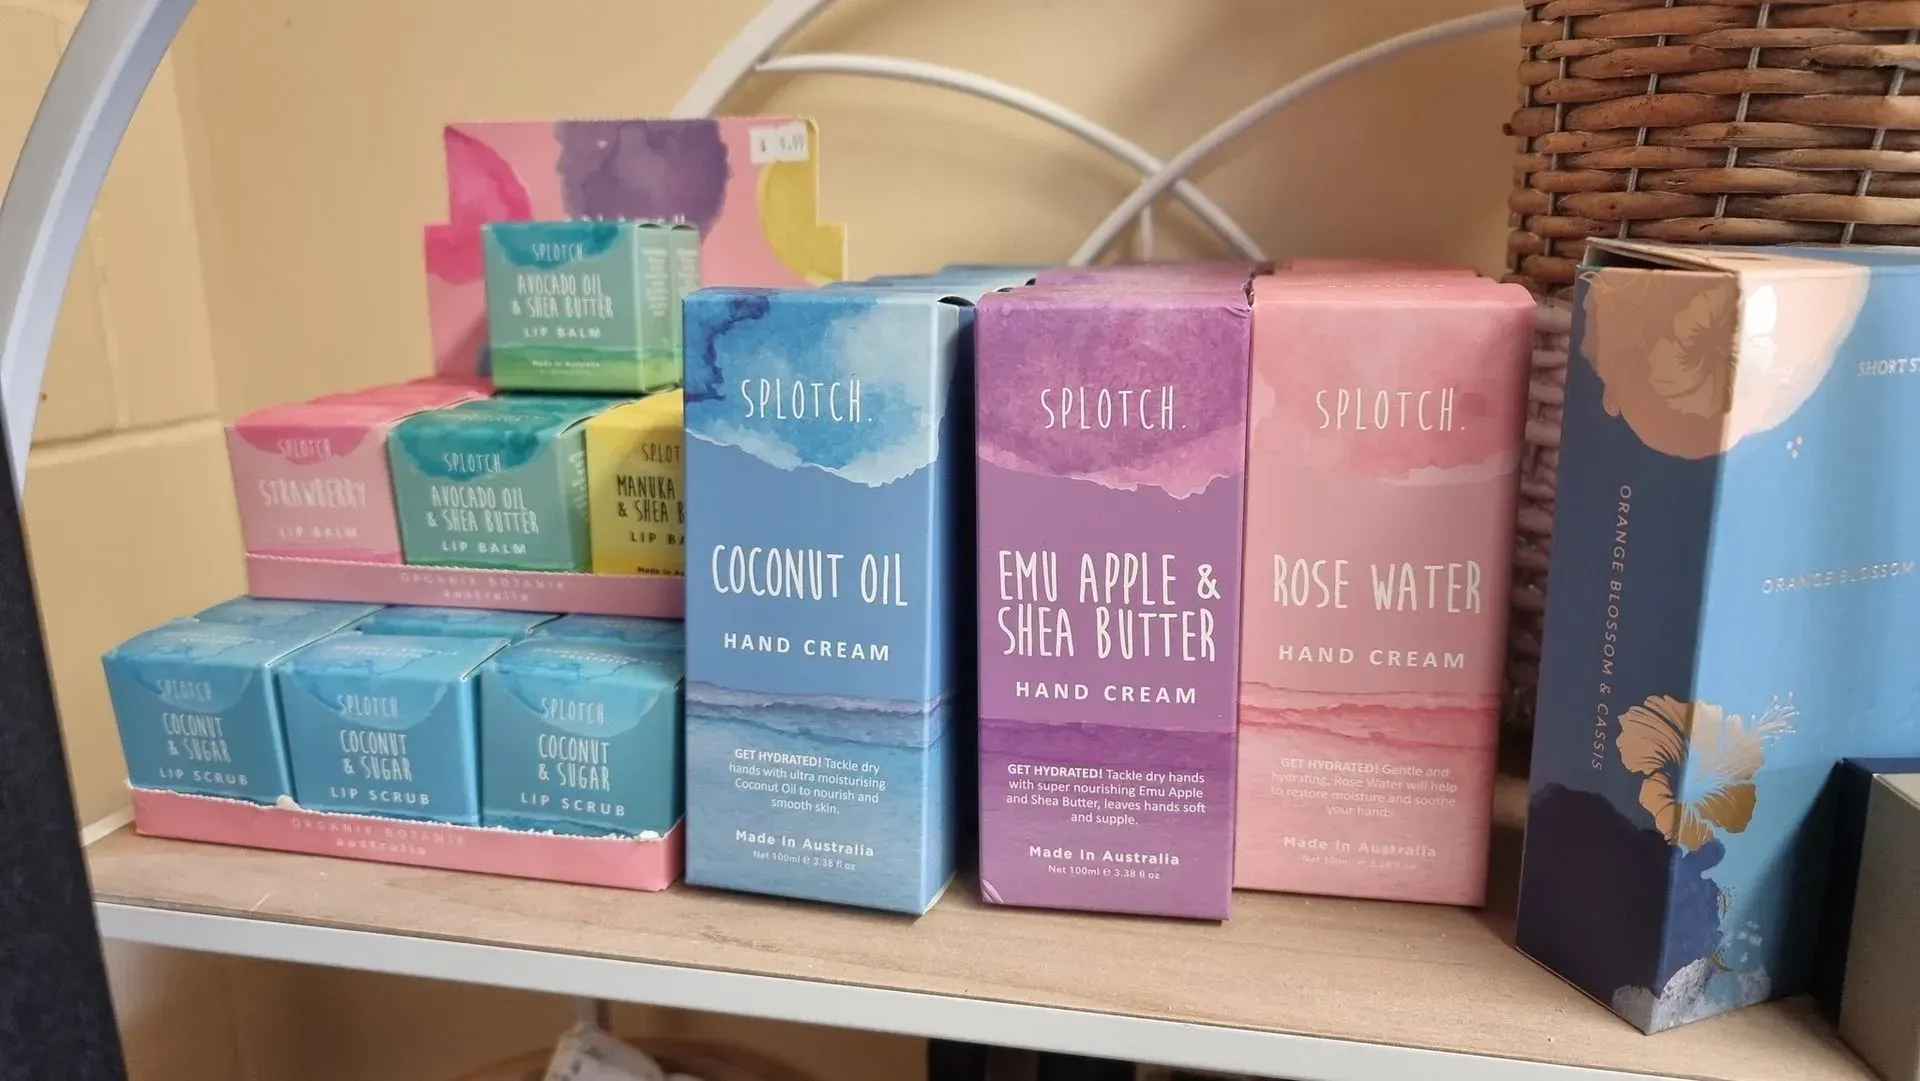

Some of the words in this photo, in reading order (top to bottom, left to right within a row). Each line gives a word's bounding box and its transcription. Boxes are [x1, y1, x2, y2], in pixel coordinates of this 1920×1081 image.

[518, 273, 576, 296] AVOCADO
[583, 274, 603, 296] OIL
[511, 300, 521, 316] &
[527, 297, 559, 318] SHEA
[566, 297, 614, 319] BUTTER
[523, 327, 548, 338] LIP
[557, 327, 601, 339] BALM
[1856, 358, 1907, 377] SHORT
[1910, 357, 1920, 373] S
[741, 378, 873, 422] SPLOTCH.
[1041, 385, 1187, 431] SPLOTCH.
[1316, 387, 1466, 432] SPLOTCH.
[642, 443, 682, 464] SPLOT
[259, 477, 366, 508] STRAWBERRY
[431, 485, 496, 509] AVOCADO
[503, 487, 527, 511] OIL
[616, 474, 676, 500] MANUKA
[426, 511, 438, 528] &
[442, 509, 479, 532] SHEA
[485, 510, 540, 535] BUTTER
[618, 501, 628, 518] &
[635, 499, 670, 524] SHEA
[279, 526, 304, 538] LIP
[313, 526, 359, 538] BALM
[630, 531, 656, 543] LIP
[668, 533, 685, 545] BA
[1612, 485, 1632, 572] ORANGE
[442, 541, 468, 552] LIP
[478, 542, 527, 554] BALM
[400, 572, 478, 586] ORGANIK
[488, 575, 567, 590] BOTANIK
[711, 544, 844, 600] COCONUT
[860, 552, 908, 607] OIL
[999, 551, 1057, 603] EMU
[1079, 553, 1176, 606] APPLE
[1197, 563, 1221, 600] &
[1273, 554, 1349, 609] ROSE
[1370, 560, 1481, 614] WATER
[998, 606, 1075, 657] SHEA
[1096, 608, 1216, 663] BUTTER
[1601, 580, 1622, 676] BLOSSOM
[724, 633, 790, 653] HAND
[804, 639, 891, 662] CREAM
[1278, 645, 1354, 664] HAND
[1369, 650, 1465, 669] CREAM
[1016, 681, 1089, 701] HAND
[1104, 684, 1197, 704] CREAM
[1599, 682, 1611, 694] &
[162, 712, 224, 738] COCONUT
[1592, 703, 1609, 770] CASSIS
[168, 739, 179, 756] &
[184, 738, 232, 763] SUGAR
[340, 729, 407, 756] COCONUT
[539, 733, 610, 764] COCONUT
[343, 757, 355, 775] &
[360, 756, 412, 781] SUGAR
[735, 749, 756, 760] GET
[759, 751, 822, 768] HYDRATED!
[824, 757, 858, 772] Tackle
[861, 760, 880, 775] dry
[1007, 764, 1031, 776] GET
[1034, 765, 1103, 779] HYDRATED!
[1106, 768, 1143, 781] Tackle
[1145, 771, 1166, 784] dry
[1168, 772, 1205, 784] hands
[1280, 757, 1303, 769] GET
[1308, 760, 1380, 774] HYDRATED!
[1382, 763, 1423, 777] Gentle
[1425, 766, 1449, 778] and
[160, 767, 184, 778] LIP
[193, 770, 248, 785] SCRUB
[538, 763, 550, 781] &
[557, 762, 610, 792] SUGAR
[729, 761, 761, 775] hands
[763, 765, 787, 779] with
[789, 769, 815, 782] ultra
[818, 773, 887, 791] moisturising
[1334, 776, 1363, 788] Rose
[1366, 777, 1402, 789] Water
[1406, 778, 1428, 792] will
[1430, 780, 1458, 794] help
[331, 786, 358, 798] LIP
[368, 789, 430, 805] SCRUB
[735, 777, 779, 793] Coconut
[781, 783, 796, 795] Oil
[799, 785, 811, 796] to
[813, 787, 854, 801] nourish
[858, 791, 879, 803] and
[1009, 779, 1034, 790] with
[1037, 781, 1070, 794] super
[1073, 783, 1136, 798] nourishing
[1139, 787, 1165, 798] Emu
[1168, 787, 1204, 801] Apple
[1271, 786, 1283, 796] to
[1286, 787, 1329, 800] restore
[1331, 789, 1386, 803] moisture
[1388, 793, 1411, 805] and
[1414, 794, 1457, 807] soothe
[521, 792, 550, 806] LIP
[561, 797, 625, 816] SCRUB
[771, 797, 812, 812] smooth
[815, 802, 840, 815] skin.
[1006, 794, 1028, 805] and
[1030, 795, 1059, 806] Shea
[1062, 796, 1101, 811] Butter,
[1104, 798, 1141, 811] leaves
[1144, 800, 1180, 812] hands
[1183, 802, 1207, 814] soft
[1327, 805, 1354, 818] your
[1071, 811, 1093, 823] and
[1096, 814, 1138, 827] supple.
[291, 817, 373, 835] ORGANIK
[385, 827, 468, 846] BOTANIK
[735, 829, 776, 845] Made
[782, 834, 796, 847] In
[802, 837, 874, 857] Australia
[1029, 845, 1073, 860] Made
[1080, 848, 1095, 861] In
[1102, 850, 1180, 865] Australia
[1283, 836, 1328, 850] Made
[1335, 840, 1351, 851] In
[1358, 841, 1437, 857] Australia
[753, 849, 770, 860] Net
[772, 850, 801, 864] 100ml
[813, 856, 834, 868] 3.38
[836, 859, 842, 869] fl
[845, 861, 856, 871] oz
[1048, 864, 1066, 874] Net
[1069, 865, 1100, 876] 100ml
[1114, 868, 1136, 878] 3.38
[1139, 869, 1145, 879] fl
[1148, 872, 1160, 880] oz
